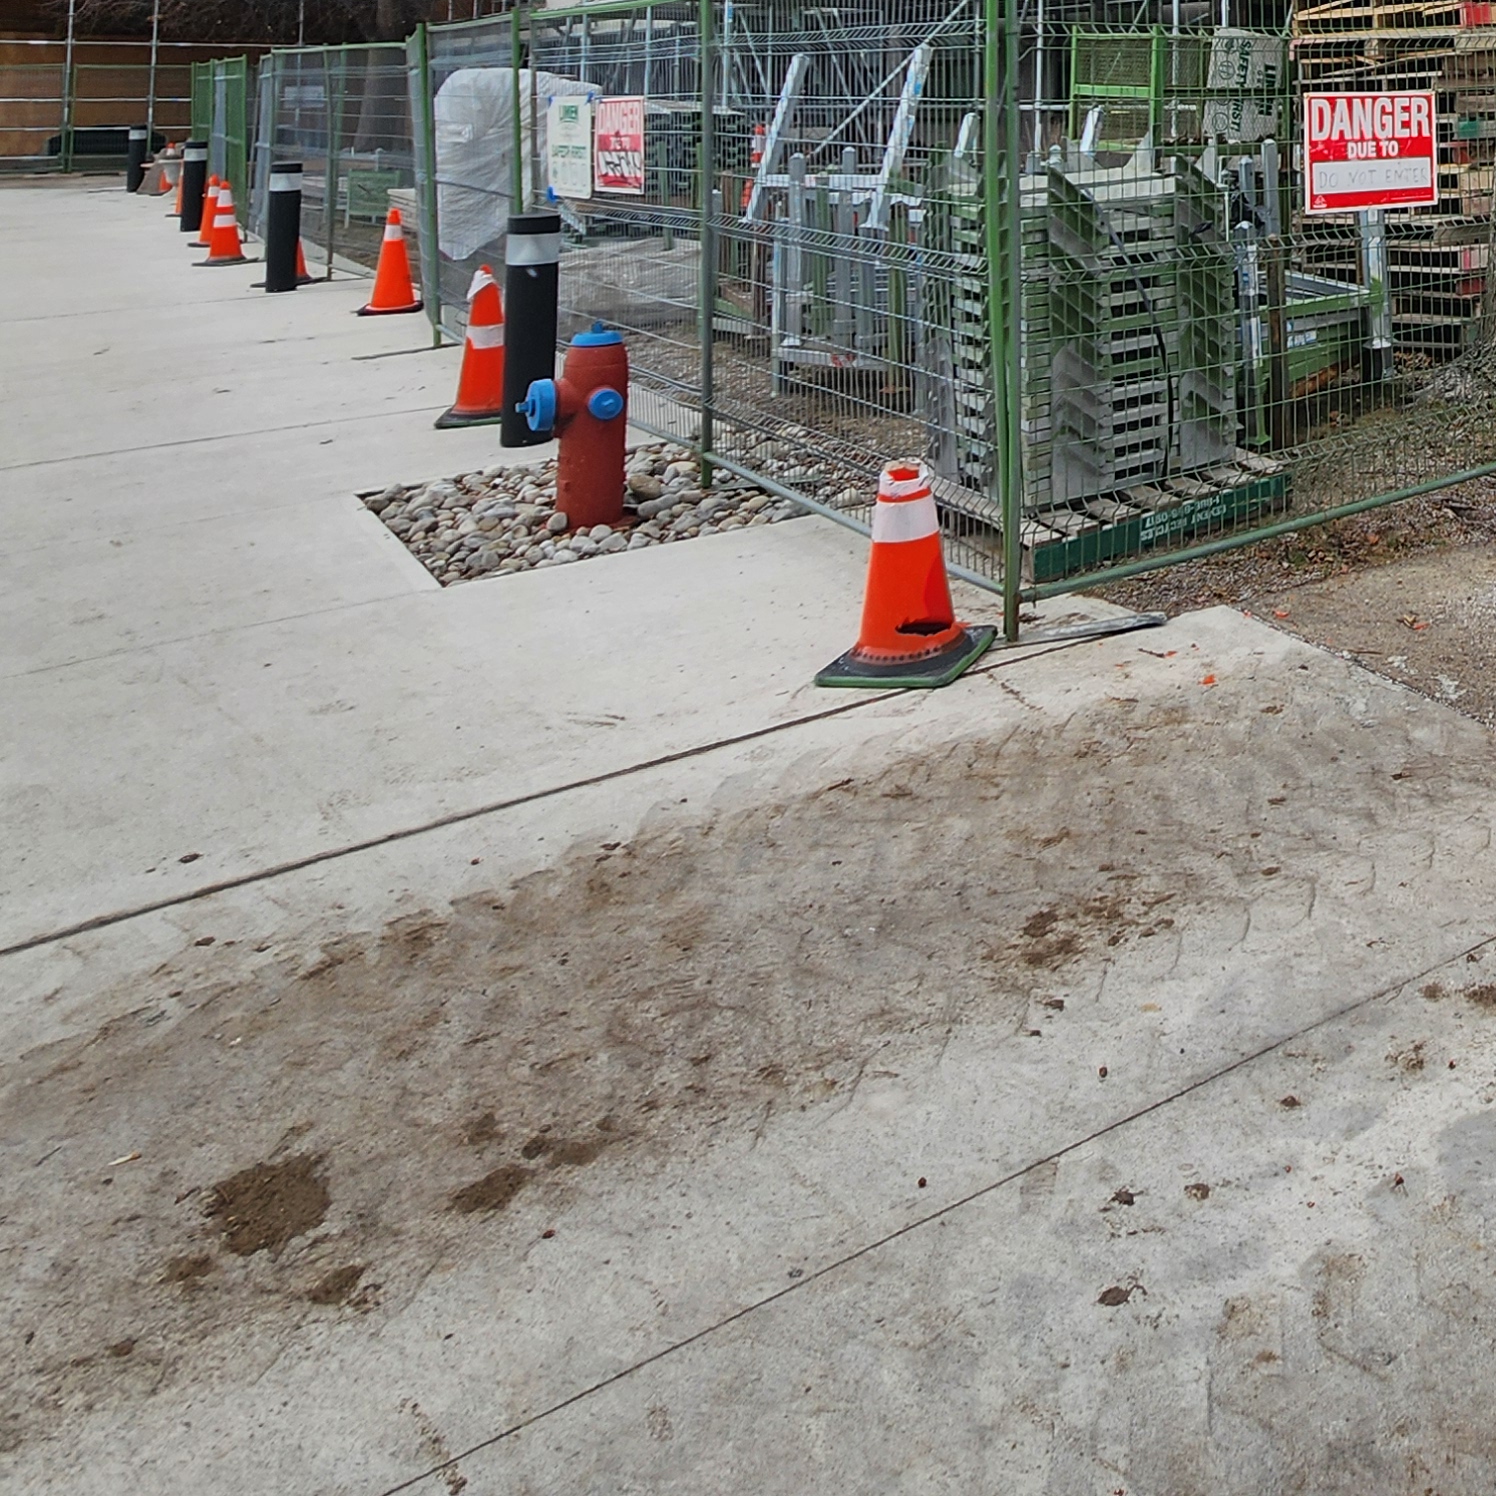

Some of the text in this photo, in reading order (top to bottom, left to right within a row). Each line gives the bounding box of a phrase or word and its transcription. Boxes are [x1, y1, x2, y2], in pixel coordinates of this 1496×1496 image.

[1235, 40, 1252, 87] SAFETY
[598, 102, 641, 134] DANGER
[1311, 97, 1431, 141] DANGER
[1347, 140, 1399, 159] DUE TO
[1319, 167, 1428, 189] DO NOT ENTER
